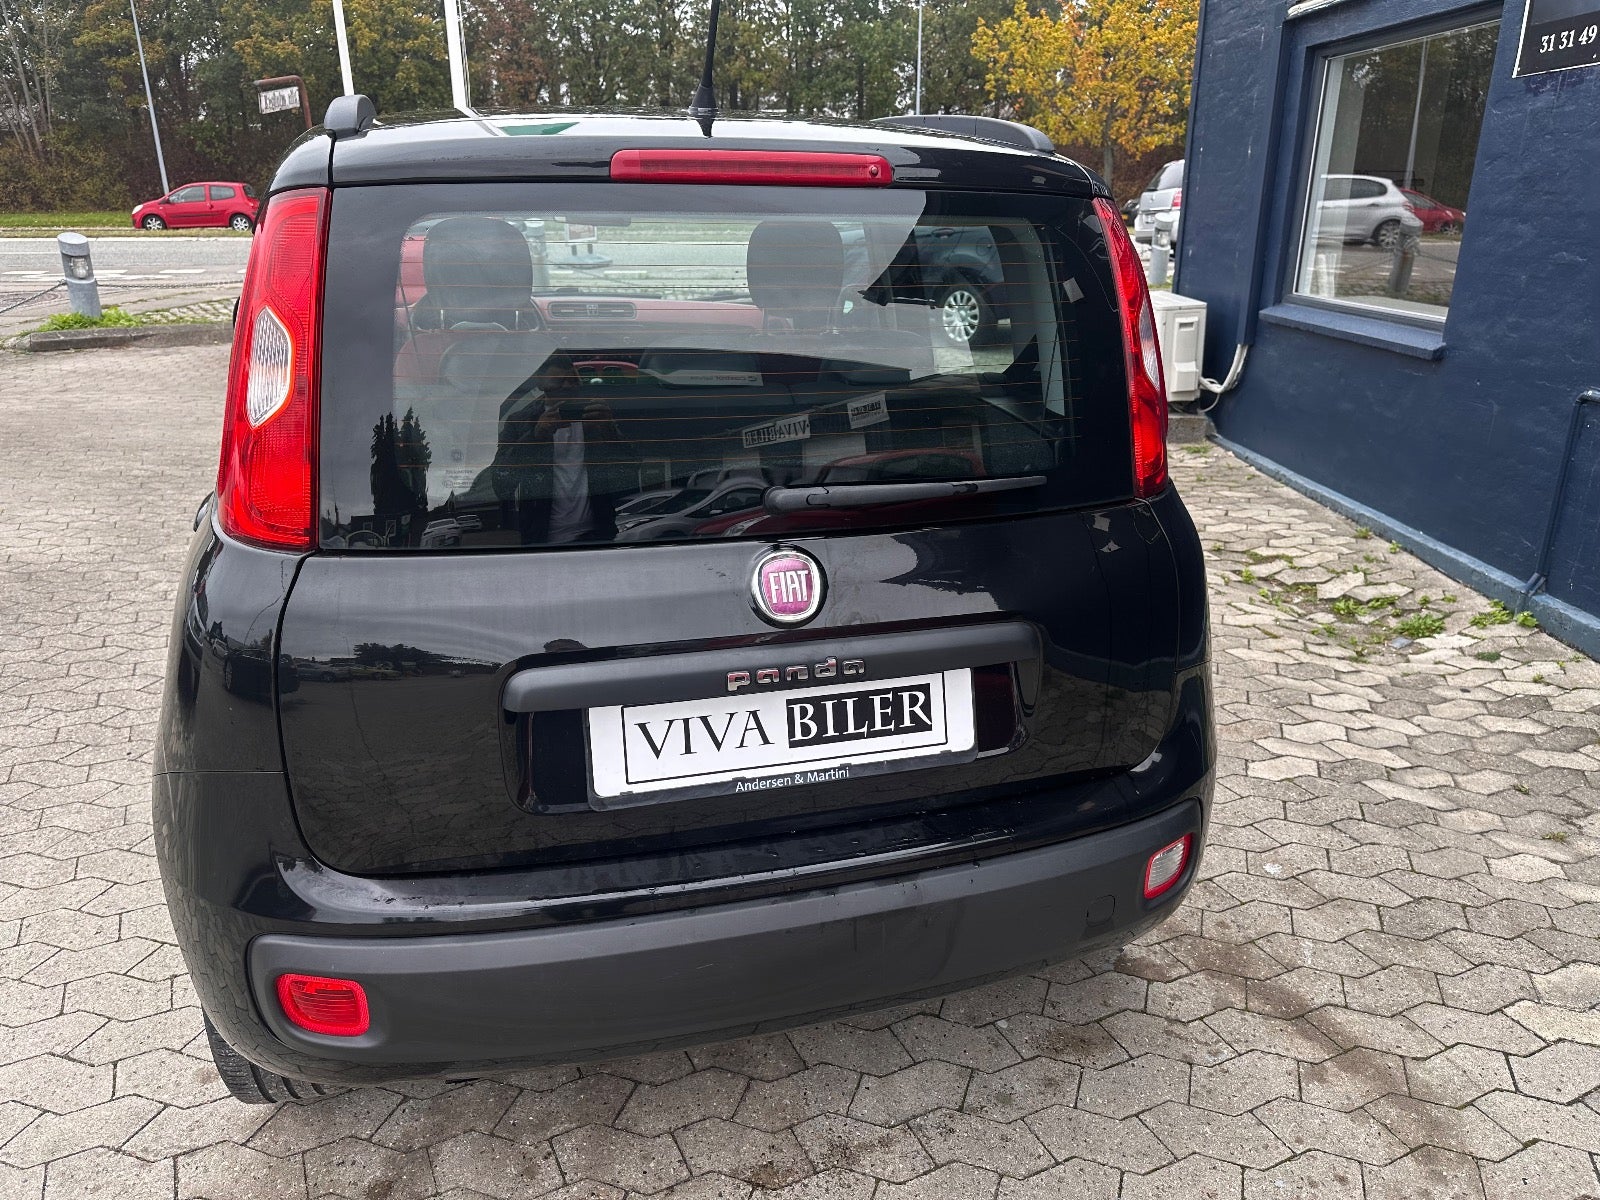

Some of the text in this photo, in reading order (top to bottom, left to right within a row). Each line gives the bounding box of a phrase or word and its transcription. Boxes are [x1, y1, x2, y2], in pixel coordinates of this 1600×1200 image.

[1539, 24, 1598, 54] 31 31 49
[768, 570, 810, 604] FIAT
[726, 656, 866, 692] panda
[634, 690, 933, 761] VIVA BILER
[735, 766, 850, 794] Andersen & Martini
